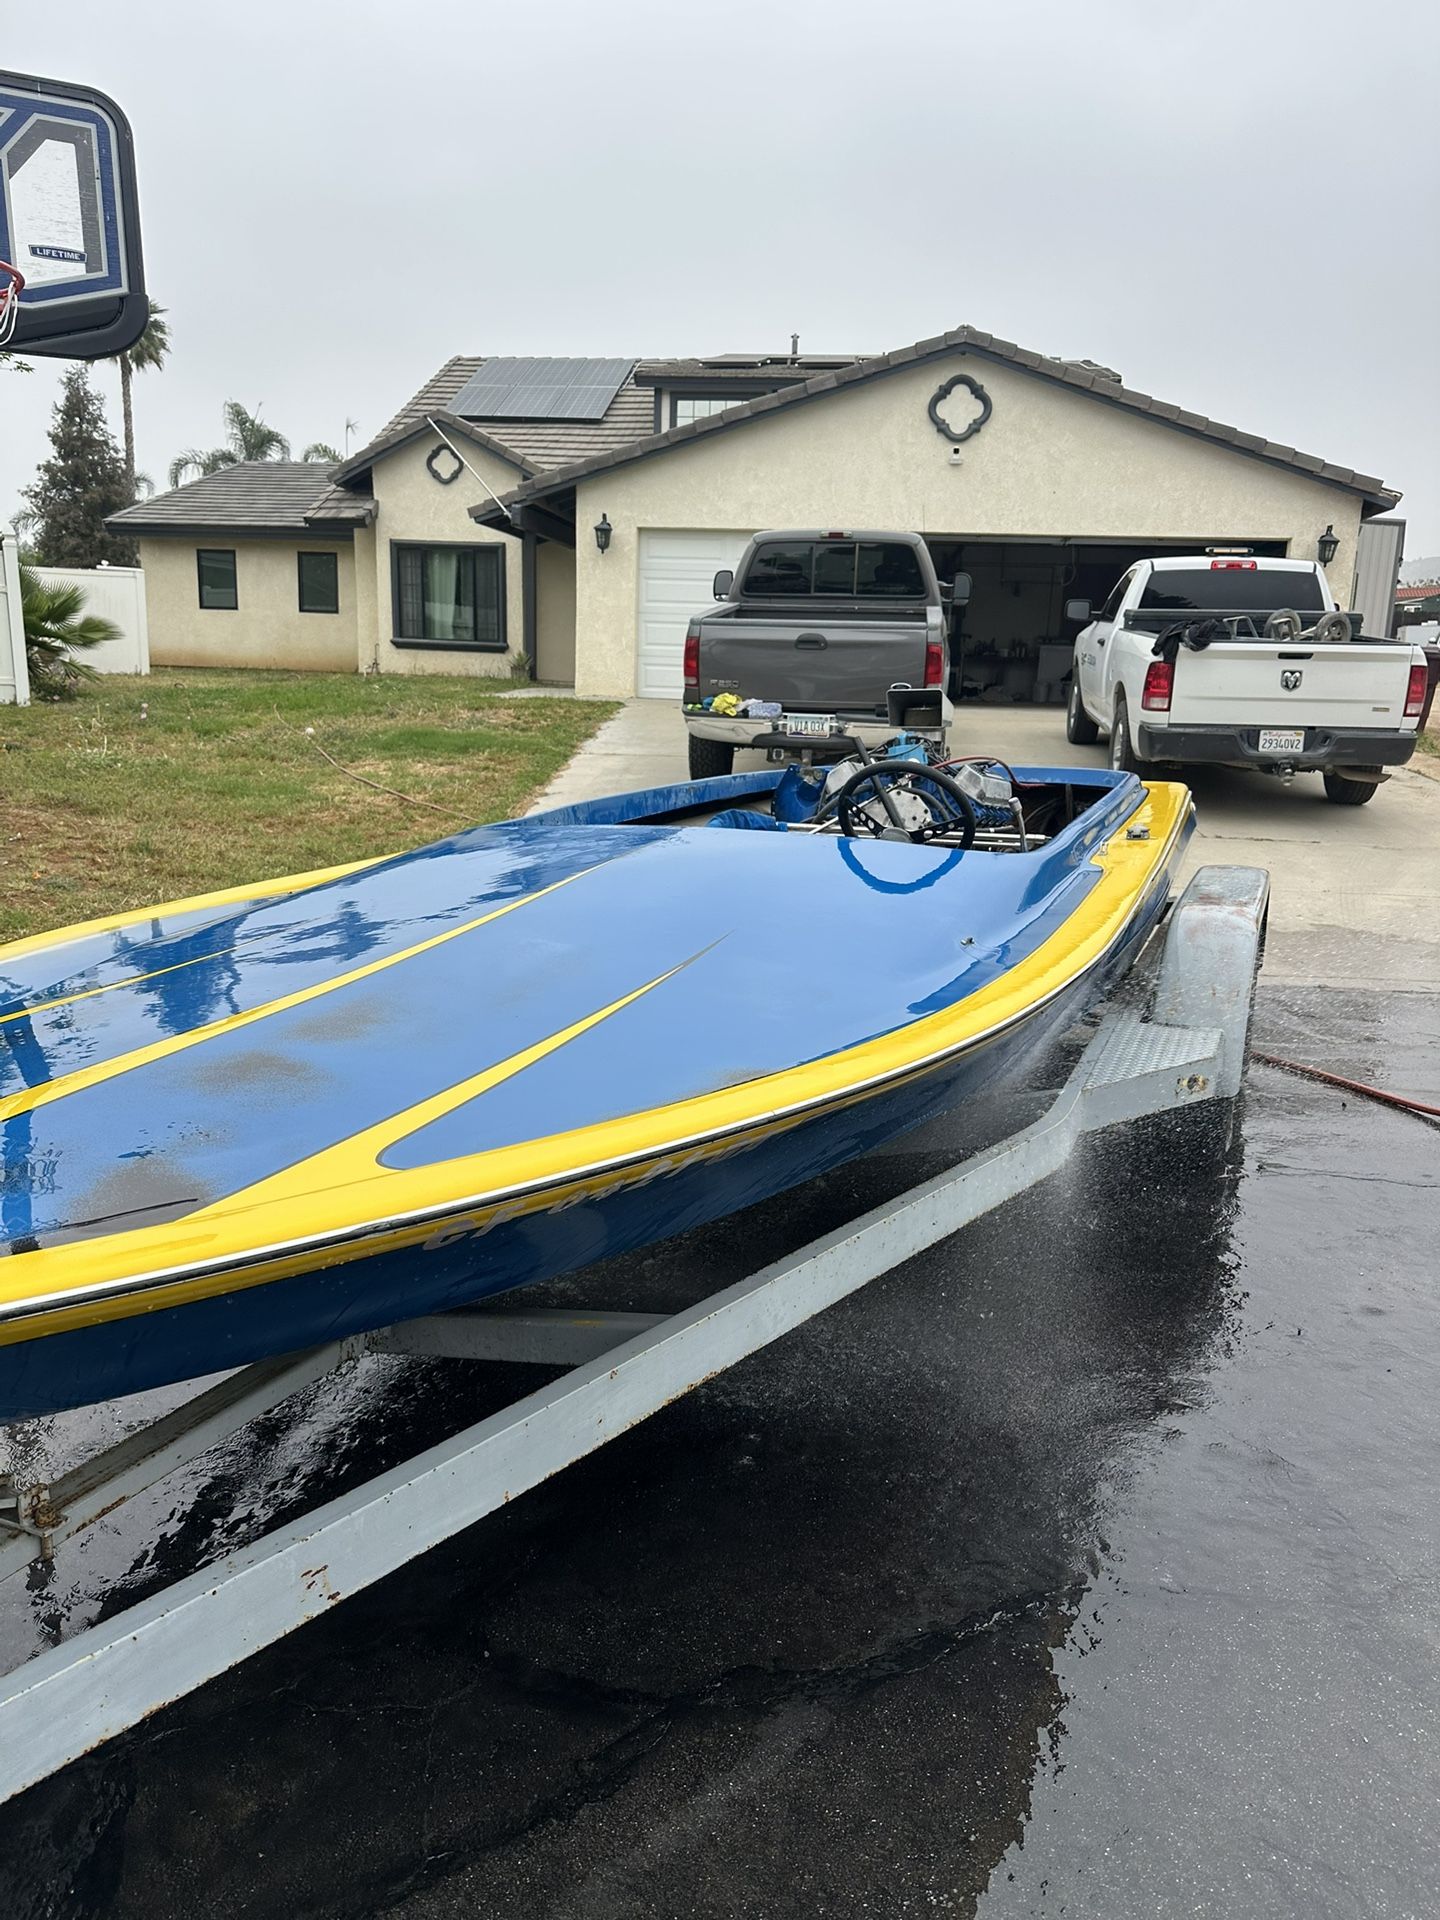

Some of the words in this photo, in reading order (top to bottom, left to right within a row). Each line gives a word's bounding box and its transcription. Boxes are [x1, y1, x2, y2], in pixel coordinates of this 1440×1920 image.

[36, 247, 81, 260] LIFETIME
[1261, 738, 1302, 750] 29340V2
[422, 1202, 526, 1251] CF
